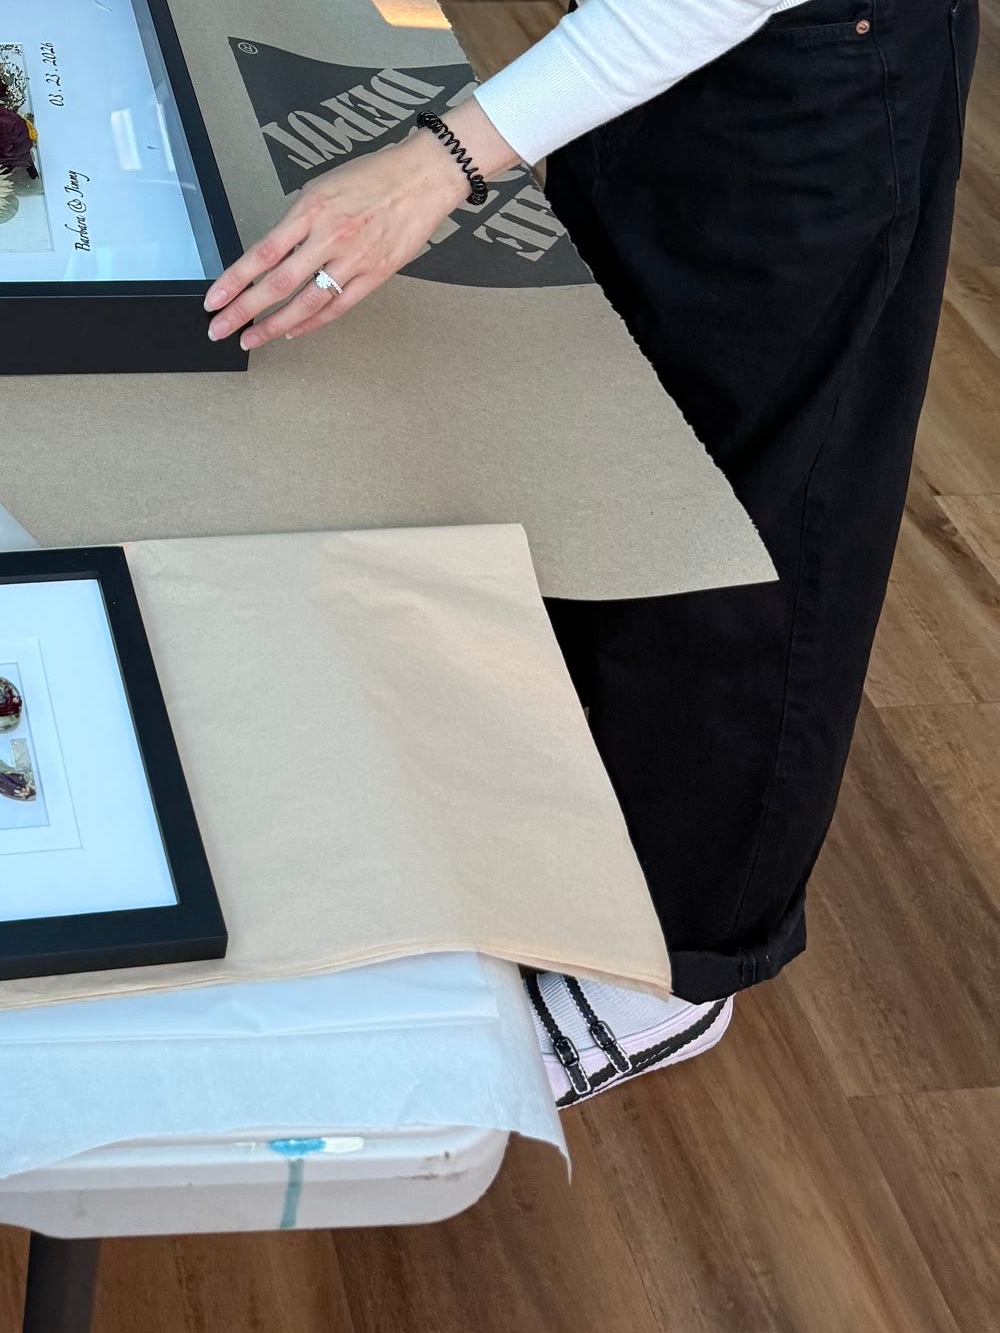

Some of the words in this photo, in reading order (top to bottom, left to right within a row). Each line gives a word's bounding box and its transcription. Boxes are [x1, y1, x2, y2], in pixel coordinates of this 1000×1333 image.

[261, 69, 445, 169] DEPOT
[64, 170, 90, 197] Jimmy
[64, 215, 90, 251] Barbara
[473, 185, 567, 262] HE
